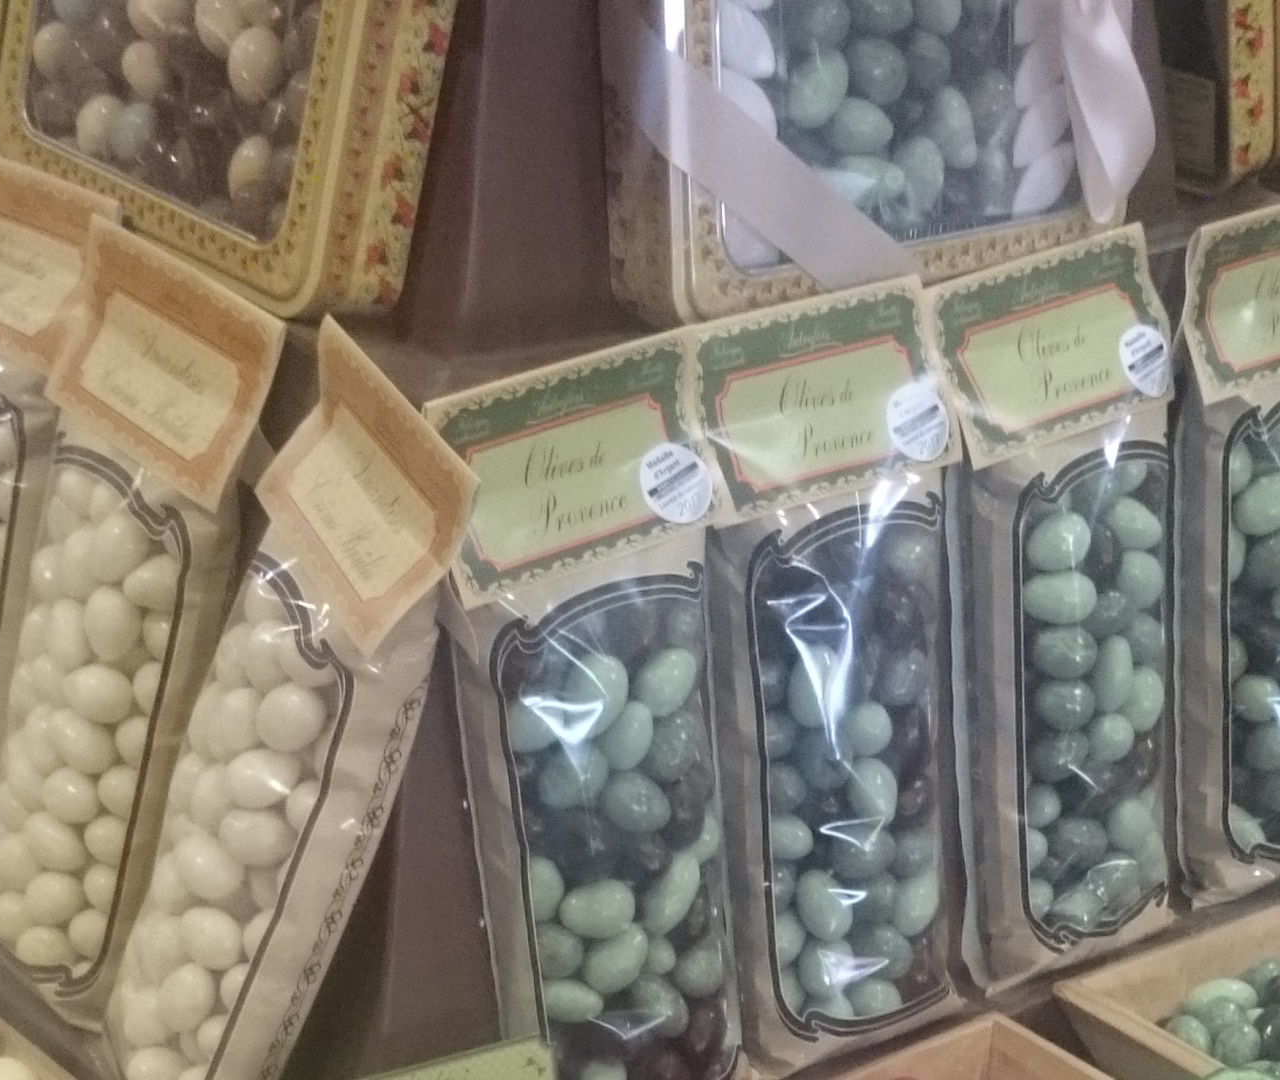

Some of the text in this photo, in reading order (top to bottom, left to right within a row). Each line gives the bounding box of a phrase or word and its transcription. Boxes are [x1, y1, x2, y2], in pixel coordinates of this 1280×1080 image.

[1018, 326, 1070, 362] Olives
[779, 377, 853, 415] Olives de
[1036, 367, 1111, 402] Provence
[796, 421, 875, 460] Provence
[524, 441, 605, 490] Olives de
[646, 449, 675, 470] Médaille
[653, 459, 681, 480] d'Argent
[530, 491, 629, 536] Provence
